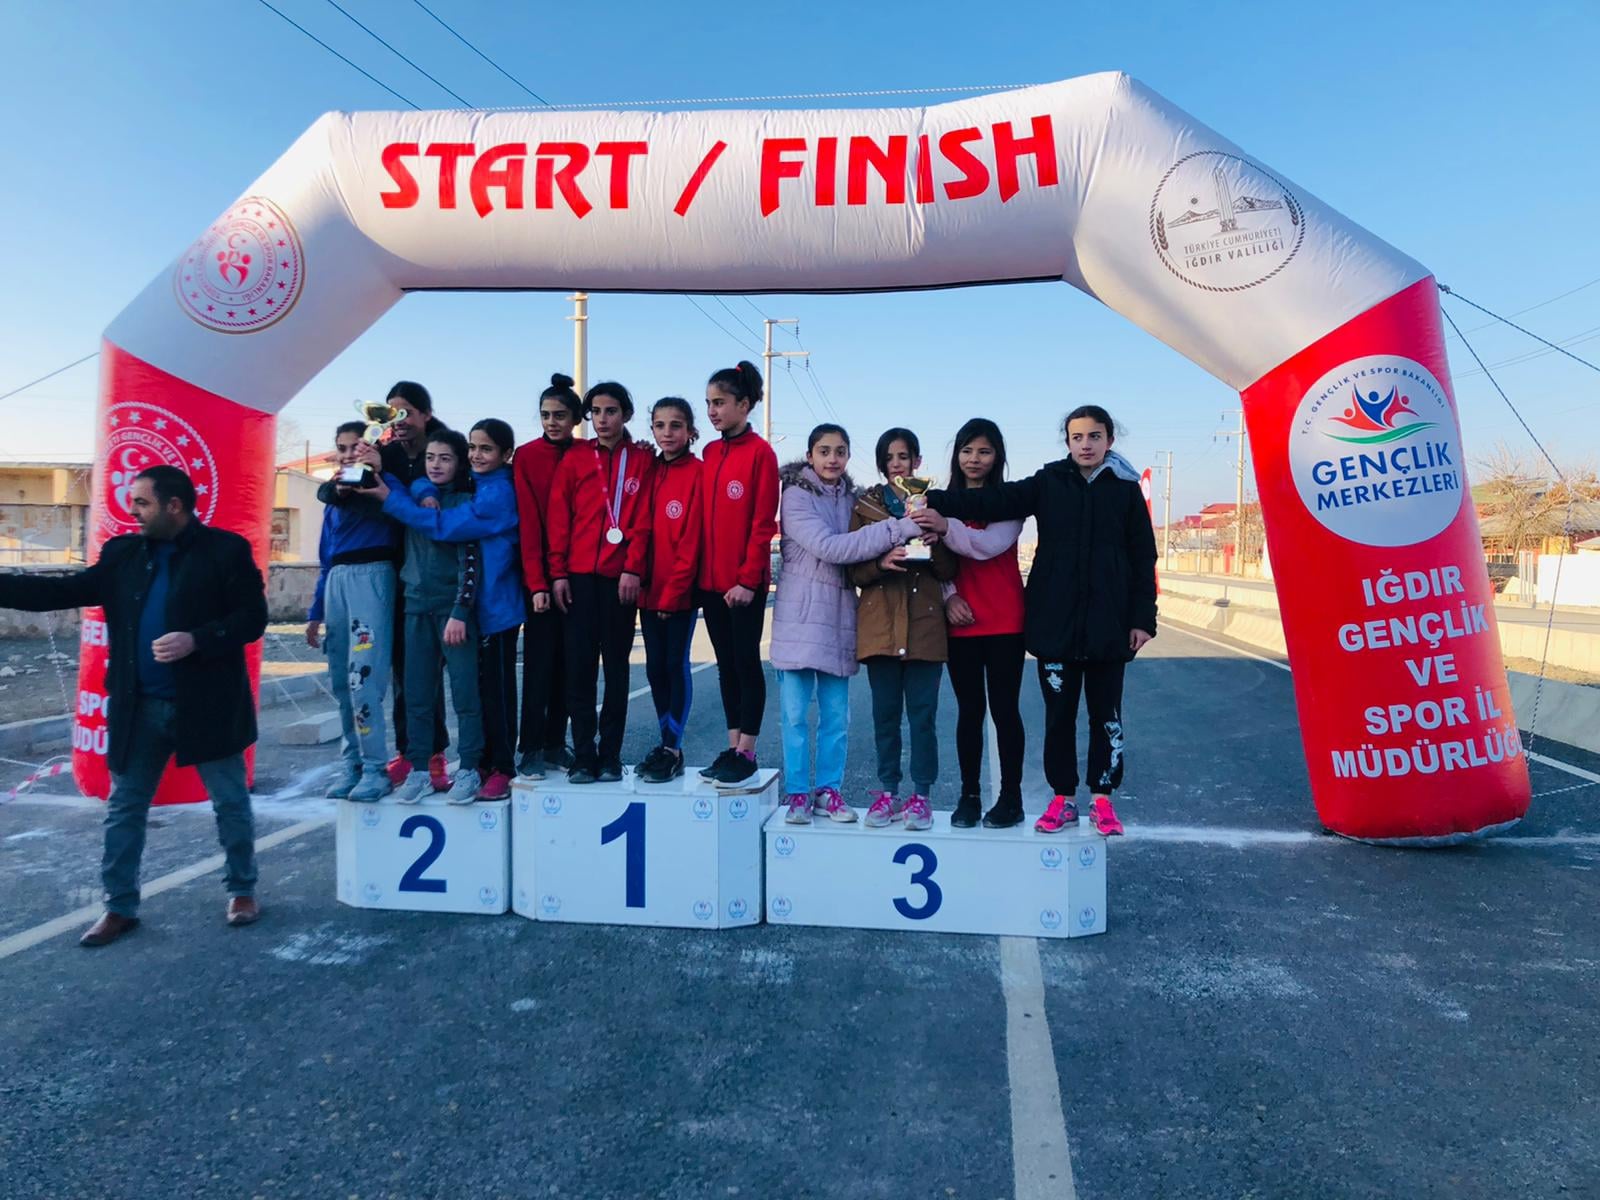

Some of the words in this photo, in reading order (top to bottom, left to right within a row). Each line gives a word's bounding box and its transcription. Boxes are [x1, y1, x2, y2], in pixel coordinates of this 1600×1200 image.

[379, 141, 648, 219] START
[673, 140, 728, 217] /
[759, 113, 1059, 218] FINISH
[1184, 239, 1220, 254] TÜRKİYE
[1223, 228, 1281, 246] CUMHURİYETİ
[1186, 252, 1222, 268] IĞDIR
[1228, 239, 1284, 260] VALİLİĞİ
[1353, 371, 1366, 379] VE
[1370, 367, 1399, 375] SPOR
[1312, 442, 1452, 485] GENÇLİK
[1317, 470, 1460, 511] MERKEZLERİ
[1361, 565, 1465, 606] IĞDIR
[1338, 600, 1489, 652] GENÇLİK
[1404, 653, 1459, 687] VE
[1364, 696, 1470, 735] SPOR
[1474, 685, 1502, 721] İL
[398, 814, 448, 894] 2
[601, 802, 646, 908] 1
[892, 842, 943, 920] 3
